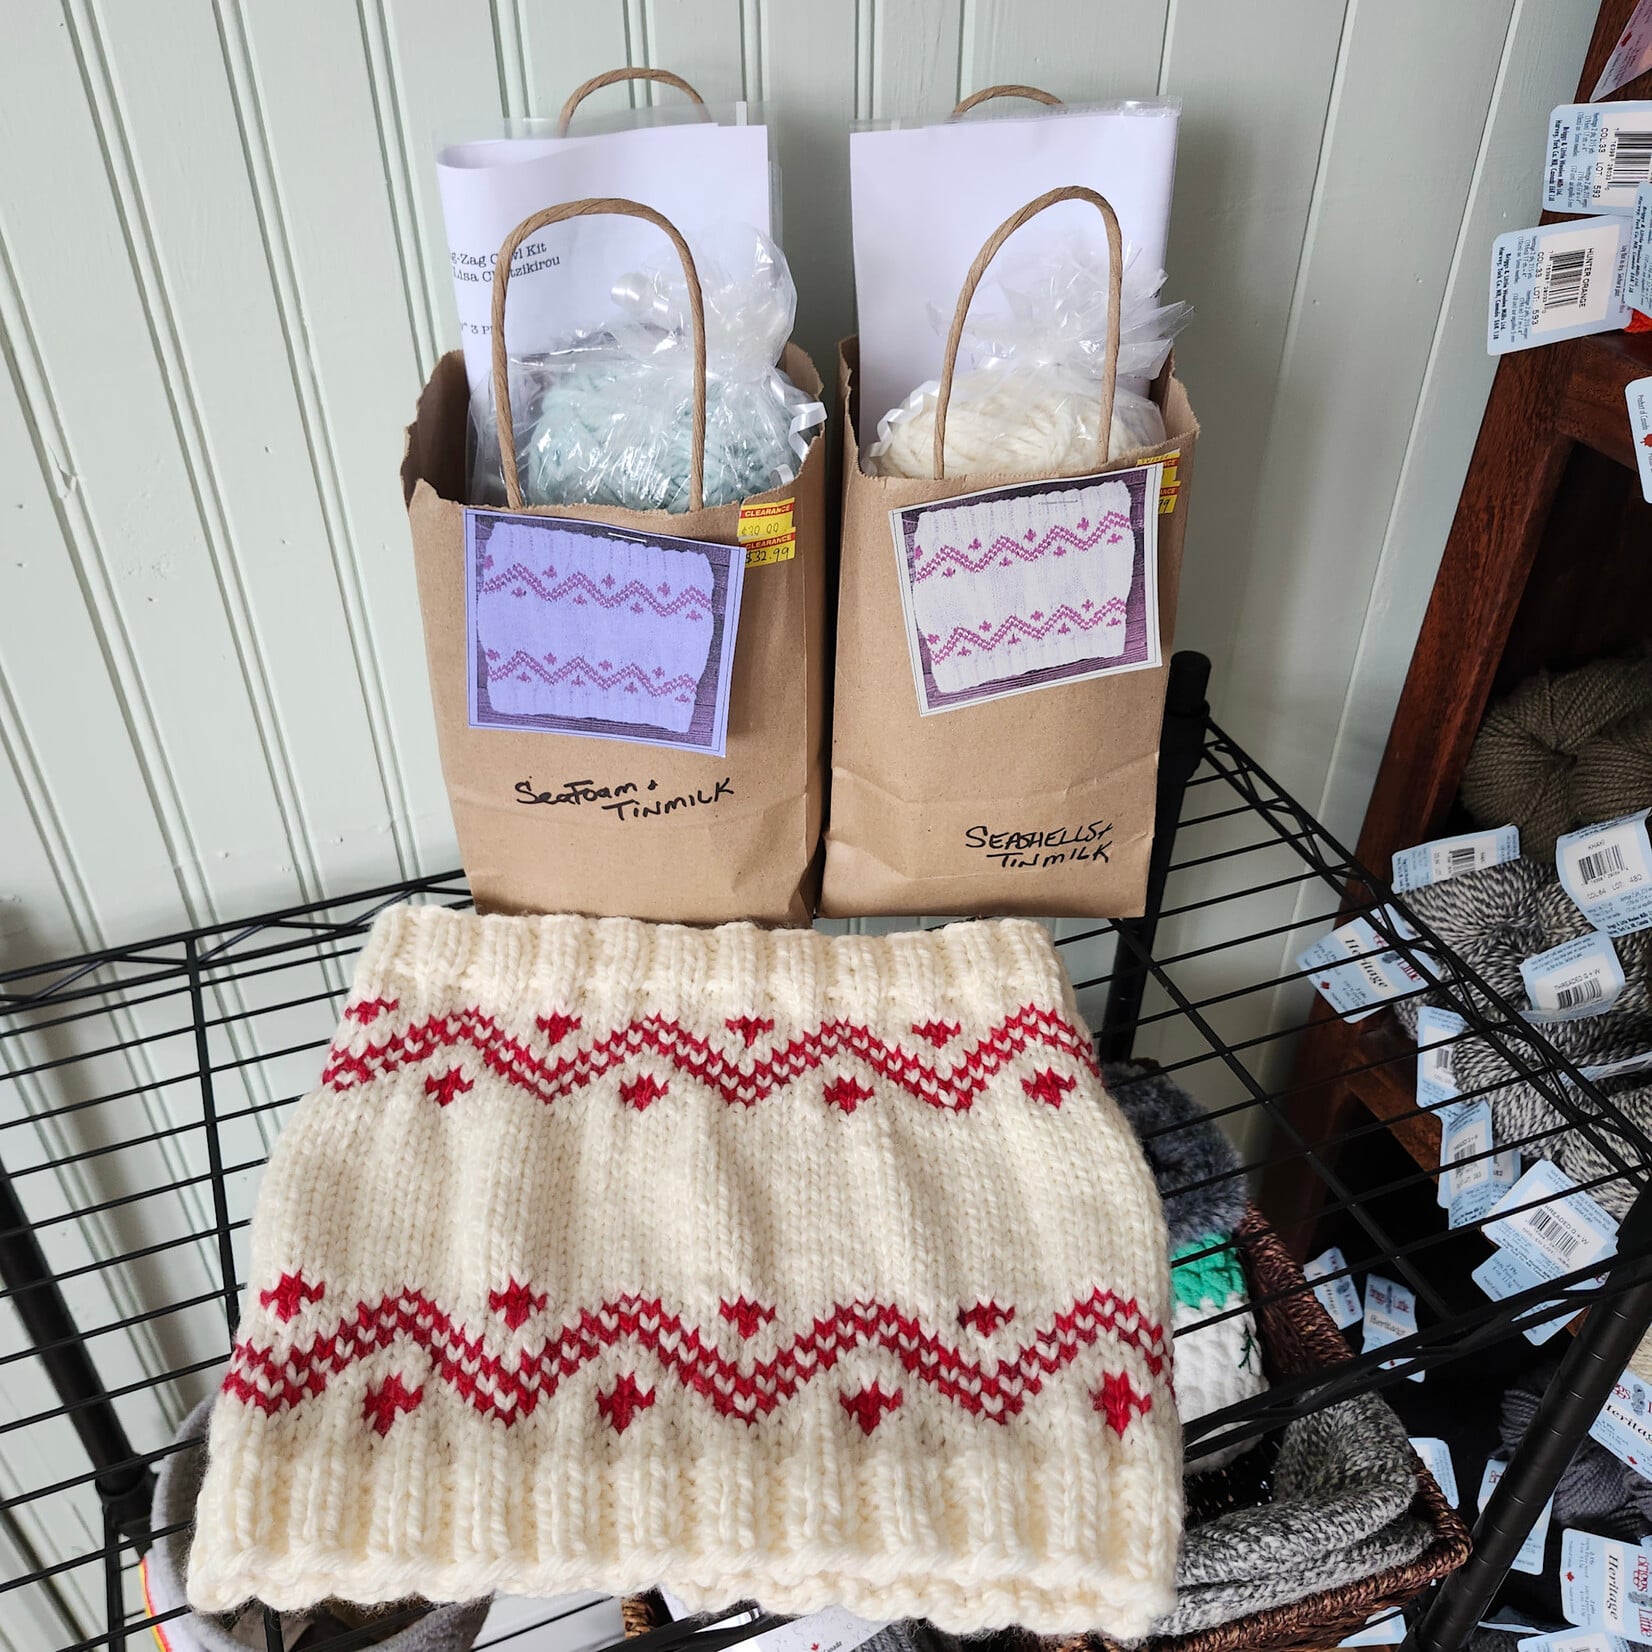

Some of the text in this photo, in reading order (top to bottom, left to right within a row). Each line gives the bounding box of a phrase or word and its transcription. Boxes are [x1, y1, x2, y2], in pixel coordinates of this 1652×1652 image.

[1592, 184, 1601, 198] 593
[526, 243, 548, 257] Kit
[482, 256, 561, 283] Ctzikirou
[1578, 247, 1594, 309] HUNTER ORANGE
[1531, 309, 1539, 325] 593
[745, 505, 791, 518] CLEARANCE
[745, 535, 792, 550] CLEARANCE
[745, 546, 790, 563] $32.99
[1542, 1203, 1572, 1230] HREADED
[1606, 1554, 1620, 1620] Heritage
